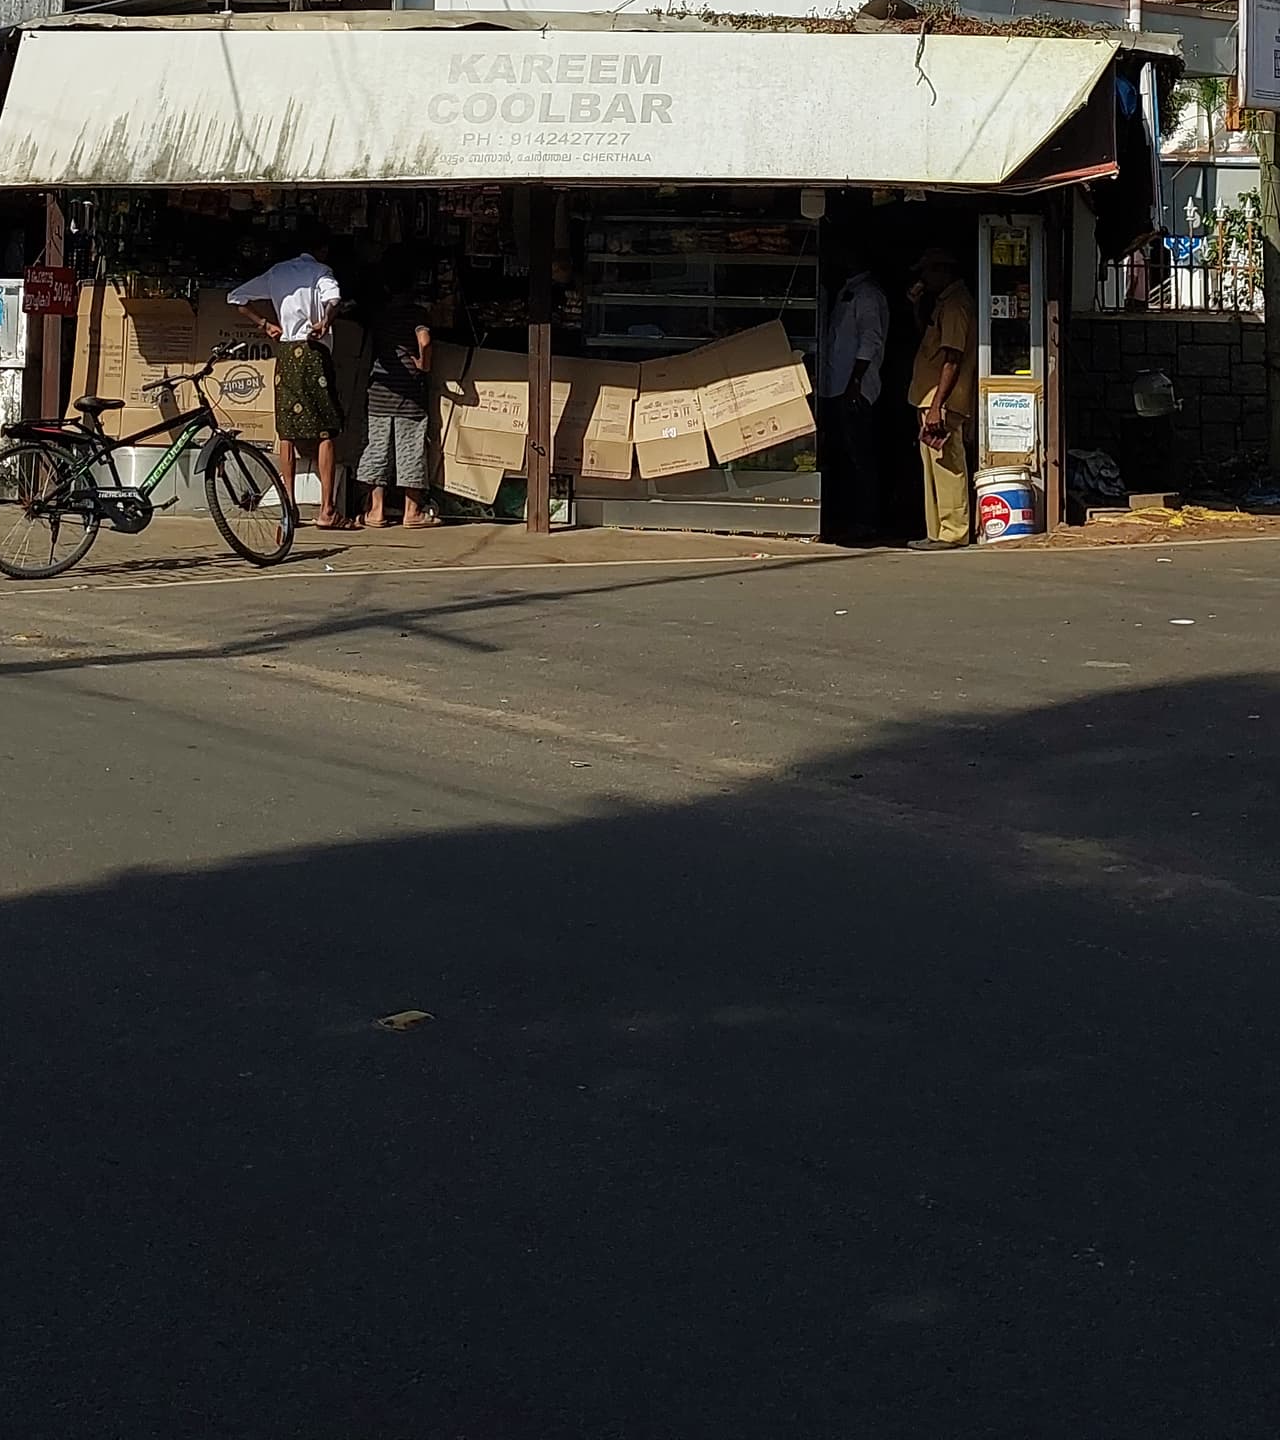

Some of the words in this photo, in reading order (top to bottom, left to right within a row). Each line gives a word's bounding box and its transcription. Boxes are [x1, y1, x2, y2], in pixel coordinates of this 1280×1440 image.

[448, 54, 663, 85] KAREEM
[427, 92, 674, 124] COOLBAR
[462, 133, 491, 147] PH
[510, 132, 631, 146] 9142427727
[582, 152, 652, 163] CHERTHALA
[222, 379, 245, 392] Rulz
[245, 377, 259, 389] No
[145, 429, 193, 489] HERCULES
